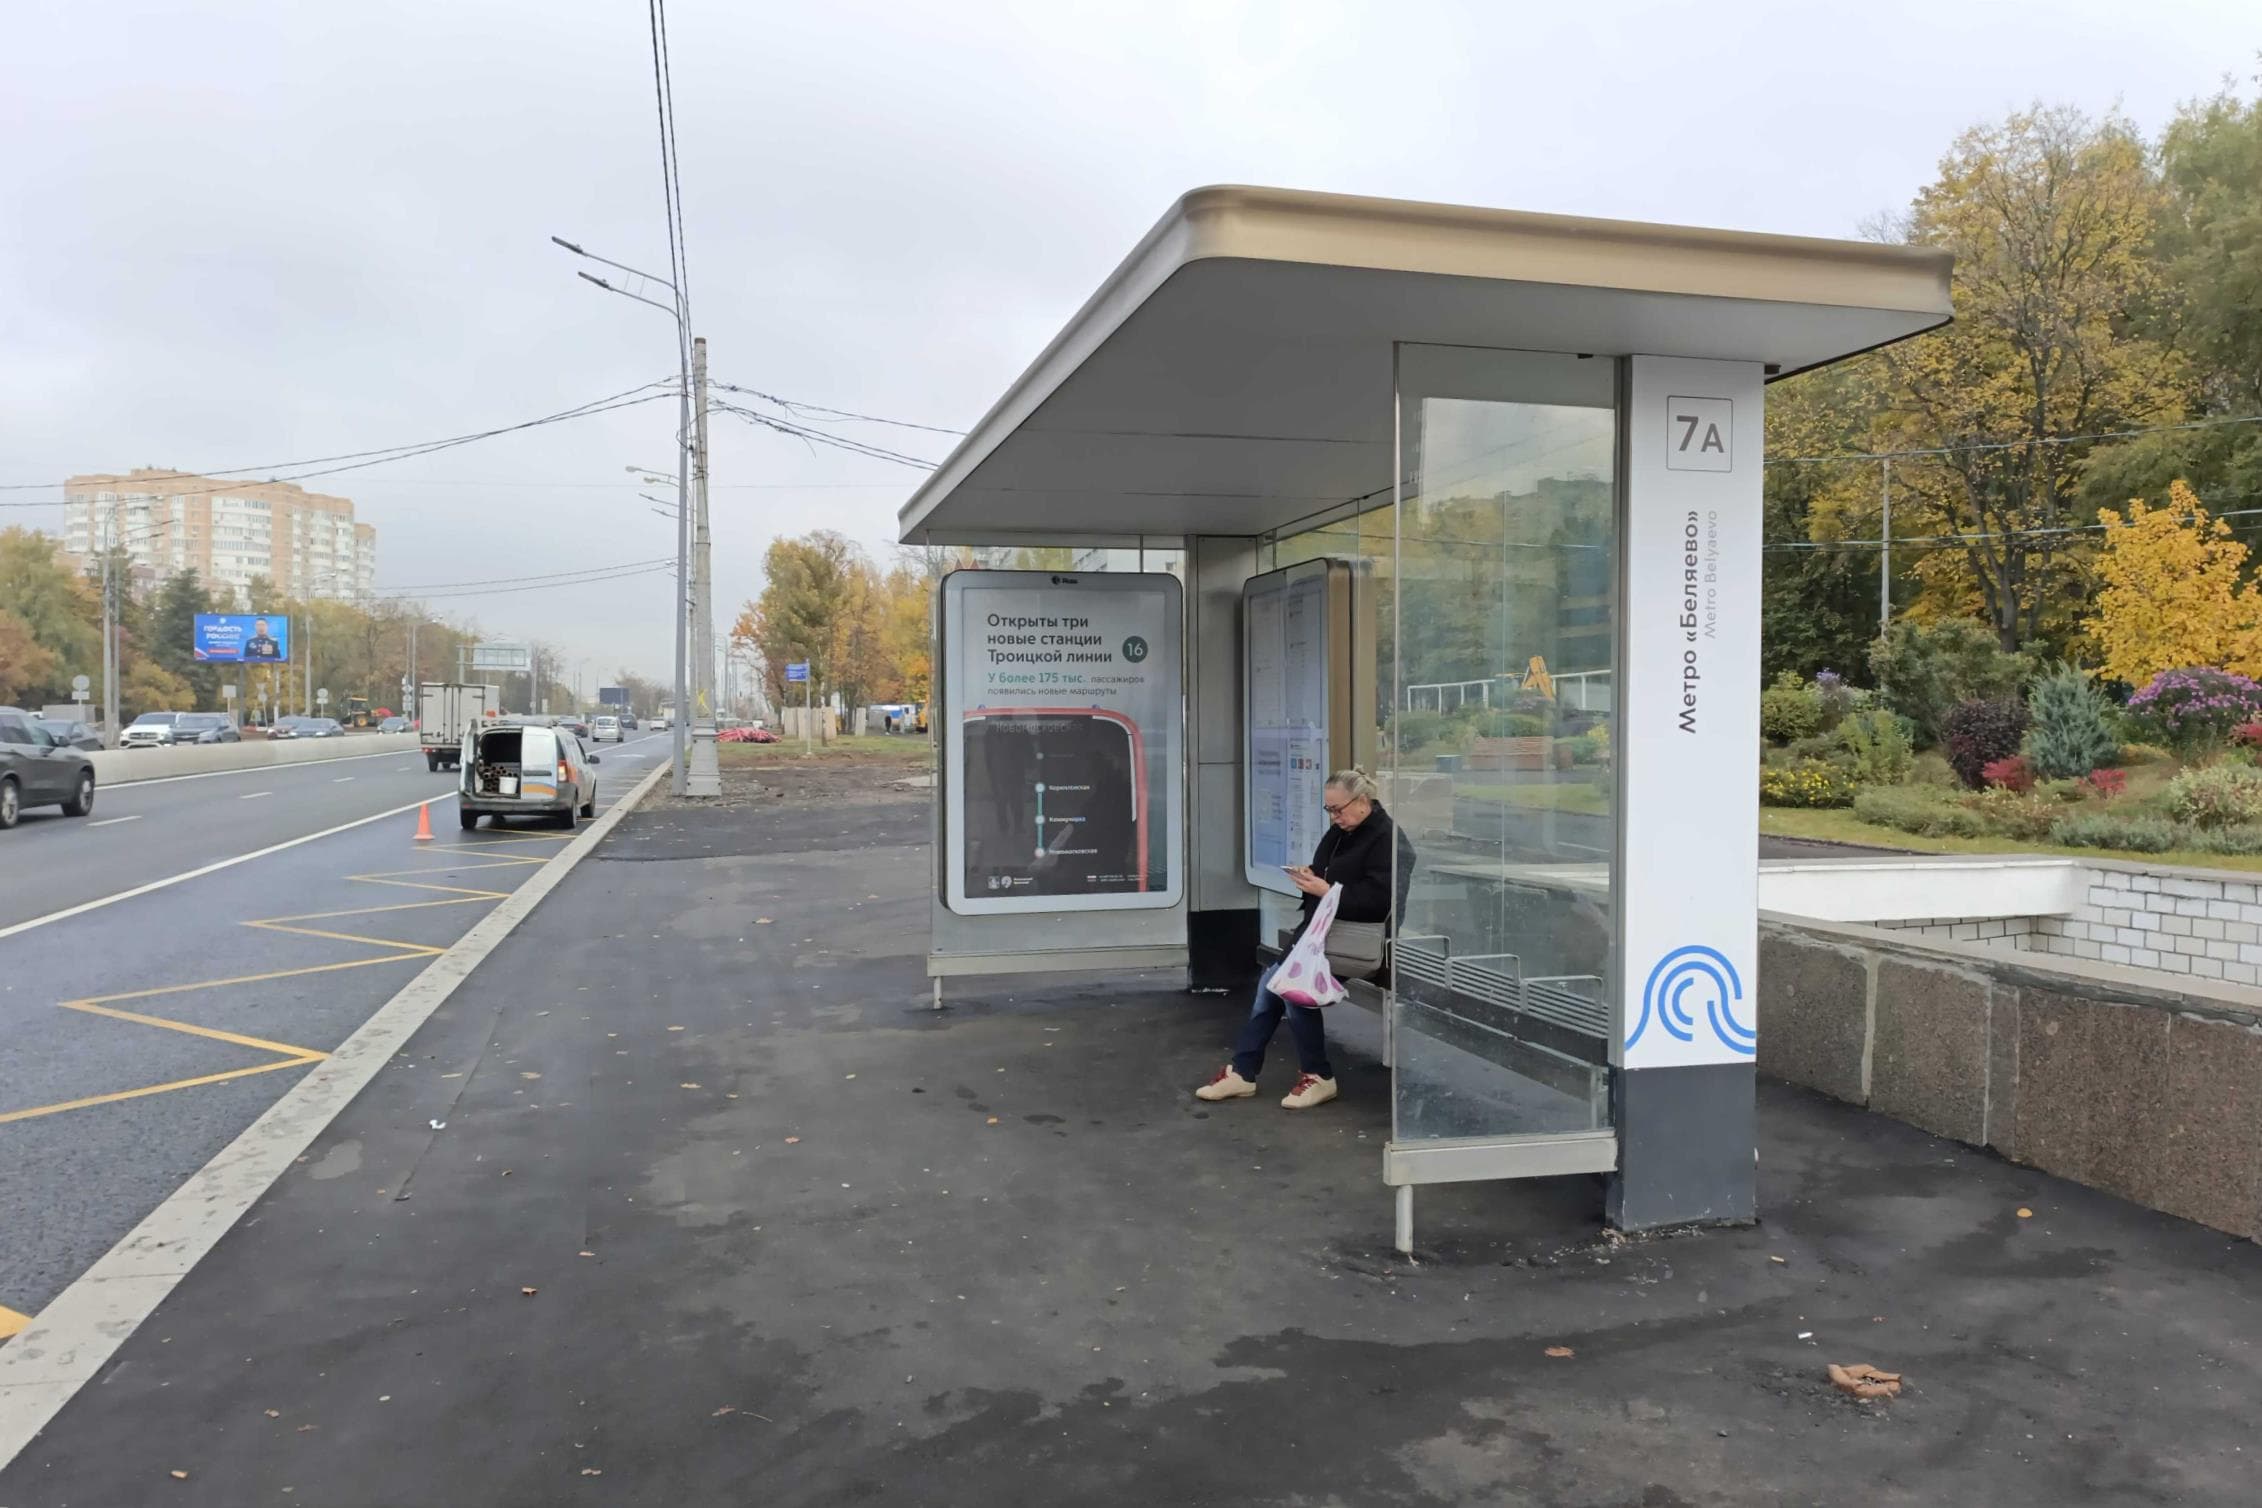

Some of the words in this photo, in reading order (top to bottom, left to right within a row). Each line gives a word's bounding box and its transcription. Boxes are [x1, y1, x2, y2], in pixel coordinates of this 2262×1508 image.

[1704, 510, 1719, 583] Belyaevo
[1679, 509, 1699, 643] «Беляево»
[1704, 588, 1716, 638] Metro
[987, 613, 1058, 630] Открыты
[1062, 616, 1089, 630] три
[987, 634, 1037, 645] новые
[1040, 634, 1102, 647] станции
[987, 649, 1062, 664] Троицкой
[1066, 651, 1112, 662] линии
[1127, 642, 1143, 656] 16
[987, 673, 996, 684] У
[998, 672, 1035, 683] более
[1039, 672, 1059, 683] 175
[1062, 674, 1087, 683] тыс.
[1091, 676, 1145, 684] пассажиров
[987, 687, 1037, 696] появились
[1038, 687, 1067, 695] новые
[1069, 687, 1117, 697] маршруты
[1678, 649, 1701, 734] Метро
